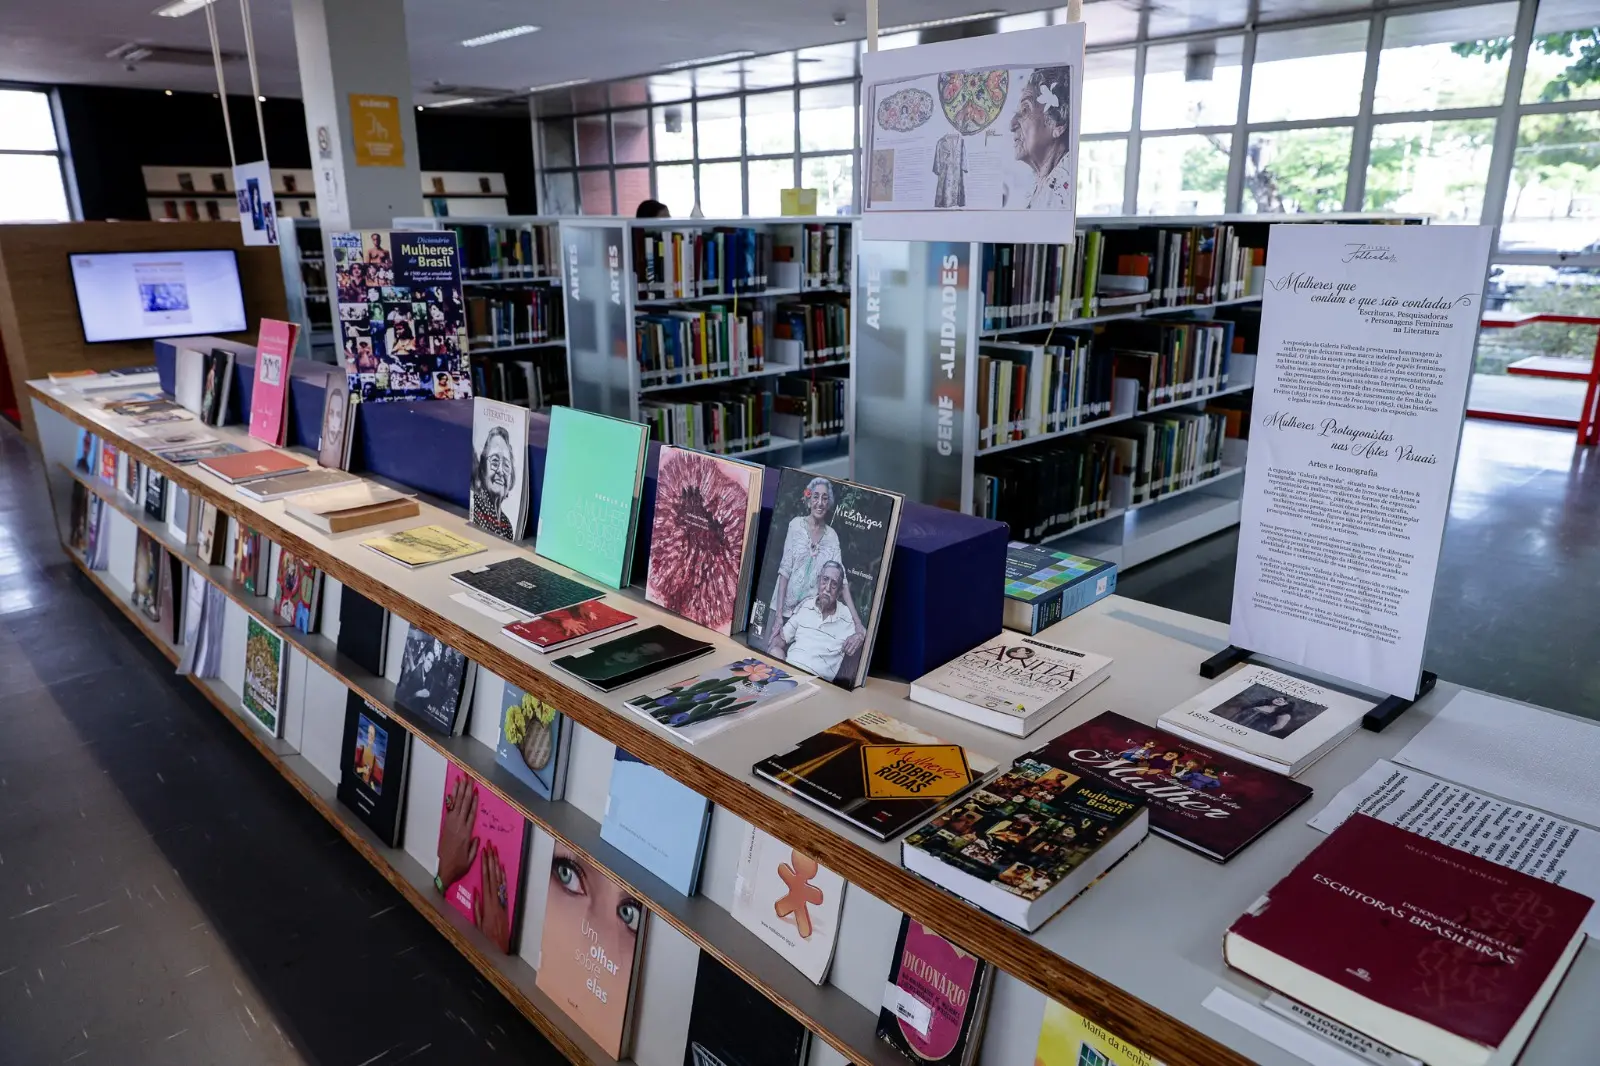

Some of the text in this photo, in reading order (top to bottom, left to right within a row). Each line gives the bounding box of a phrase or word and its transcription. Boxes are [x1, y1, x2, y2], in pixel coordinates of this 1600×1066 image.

[401, 244, 454, 255] Mulheres
[418, 256, 452, 267] Brasil
[569, 244, 580, 301] ARTES
[608, 245, 621, 305] ARTES
[1264, 273, 1357, 299] Mulheres que
[1358, 298, 1377, 310] que
[1402, 297, 1452, 310] contadas
[1359, 308, 1448, 322] Escritoras, Pesquisadoras
[1370, 316, 1413, 327] Personagens
[1415, 319, 1454, 328] Femininas
[1403, 326, 1440, 336] Literatura
[937, 254, 959, 456] GENEALIDADES
[483, 409, 514, 423] LITERATURA
[1263, 410, 1394, 442] Mulheres Protagonistas
[1331, 440, 1437, 465] nas Artes Visuais
[1308, 459, 1328, 470] Artes
[1335, 464, 1378, 478] Iconografia
[963, 654, 1069, 689] GARIBALDI
[972, 645, 1075, 682] ANITA
[874, 765, 928, 794] RODAS
[889, 760, 942, 785] SOBRE
[1068, 748, 1230, 820] Mulher
[1077, 788, 1134, 811] Mulheres
[1086, 797, 1125, 815] Brasil
[581, 919, 598, 943] Um
[1312, 873, 1517, 965] ESCRITORAS BRASILEIRAS
[575, 949, 601, 978] sobre
[590, 943, 619, 976] olhar
[586, 977, 607, 1004] elas
[903, 950, 966, 1007] DICIONÁRIO
[1082, 1017, 1150, 1066] Maria da Penha
[1291, 1005, 1394, 1059] BIBLIOGRAFIA DE
[1306, 1021, 1369, 1054] MULHERES
